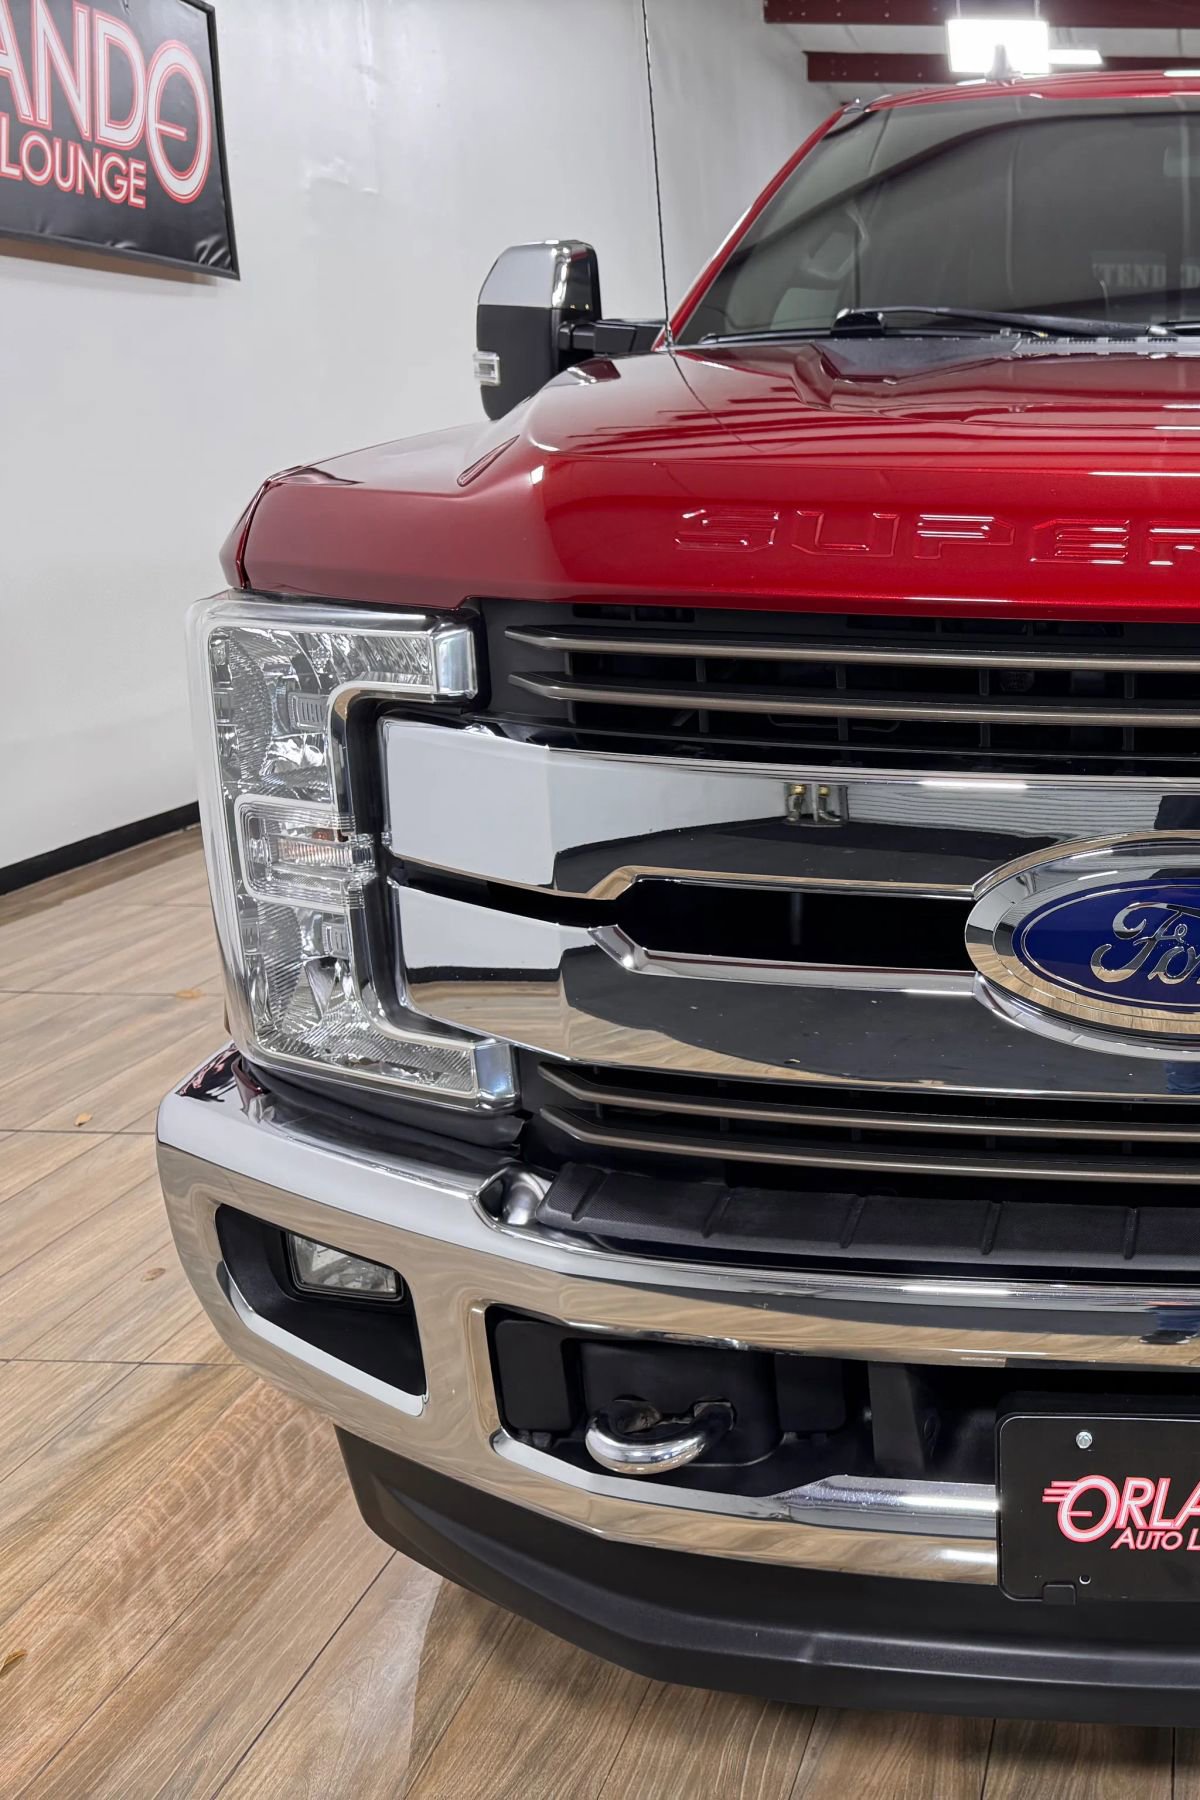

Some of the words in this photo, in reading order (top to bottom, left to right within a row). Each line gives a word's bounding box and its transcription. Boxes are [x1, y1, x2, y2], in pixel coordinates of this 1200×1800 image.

[0, 112, 146, 208] LOUNGE
[1092, 262, 1200, 289] TENDD
[1110, 1526, 1183, 1551] AUTO
